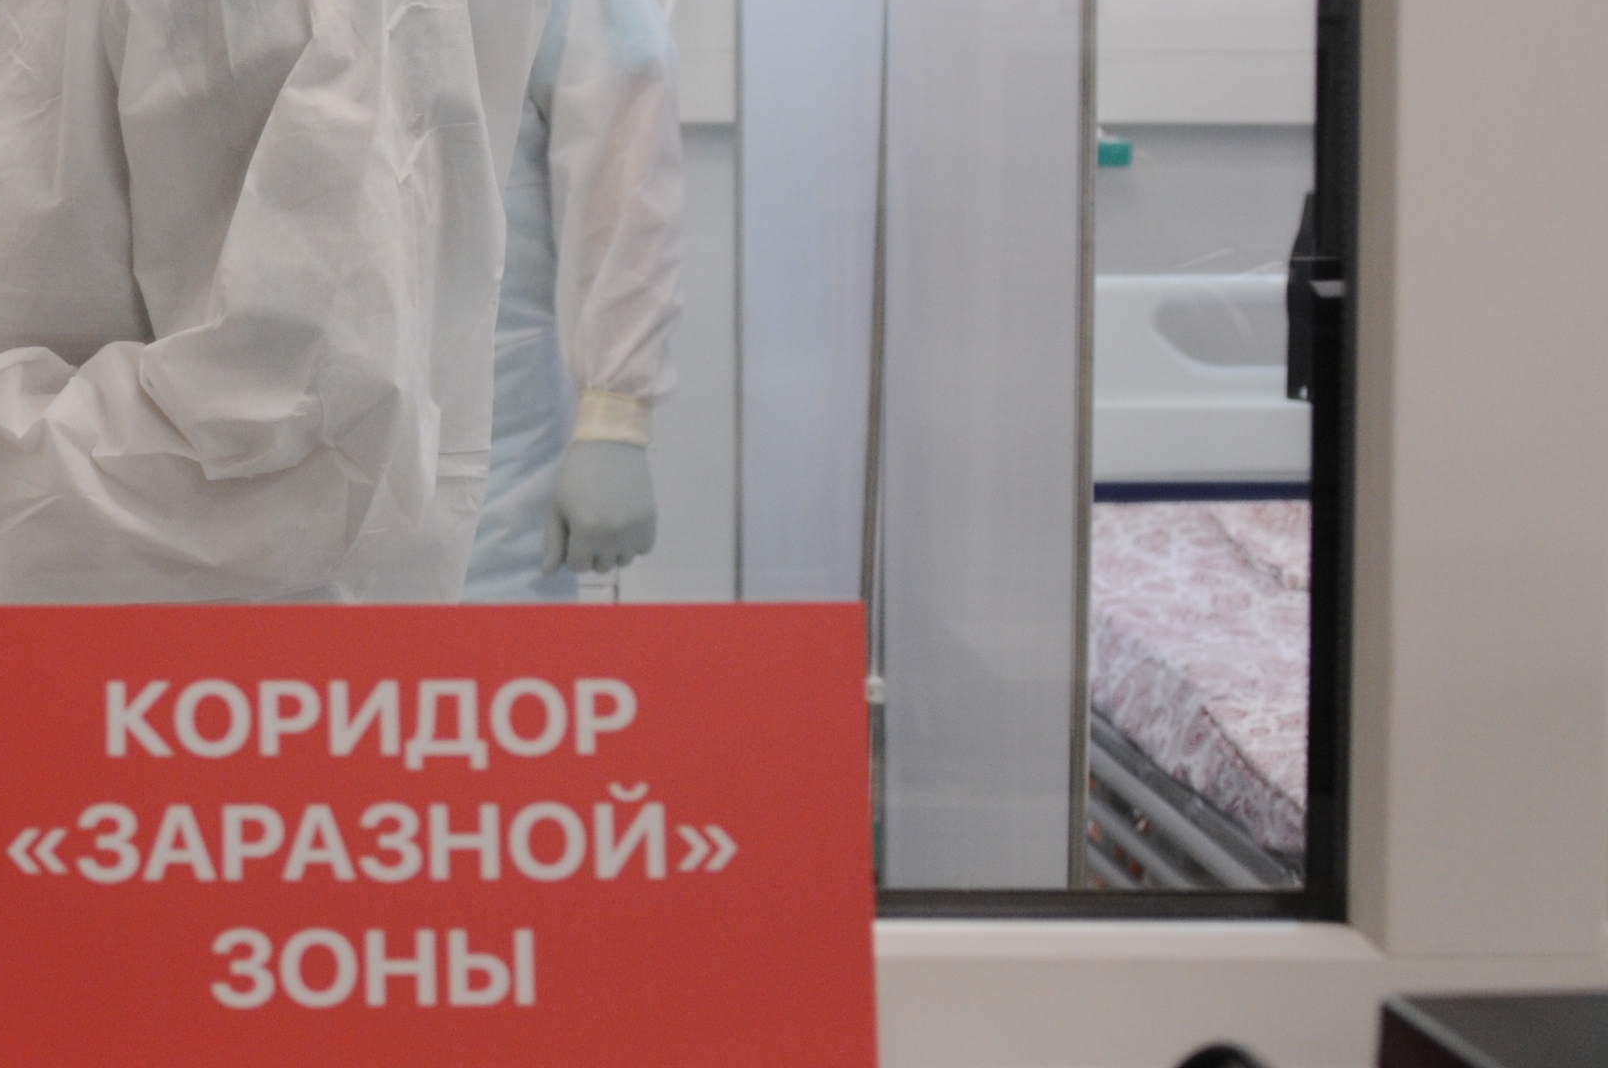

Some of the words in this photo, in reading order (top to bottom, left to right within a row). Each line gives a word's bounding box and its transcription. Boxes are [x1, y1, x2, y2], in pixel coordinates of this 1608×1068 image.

[106, 677, 637, 770] КОРИДОР
[7, 783, 737, 883] «ЗАРАЗНОЙ»
[213, 928, 536, 1009] ЗОНЫ
